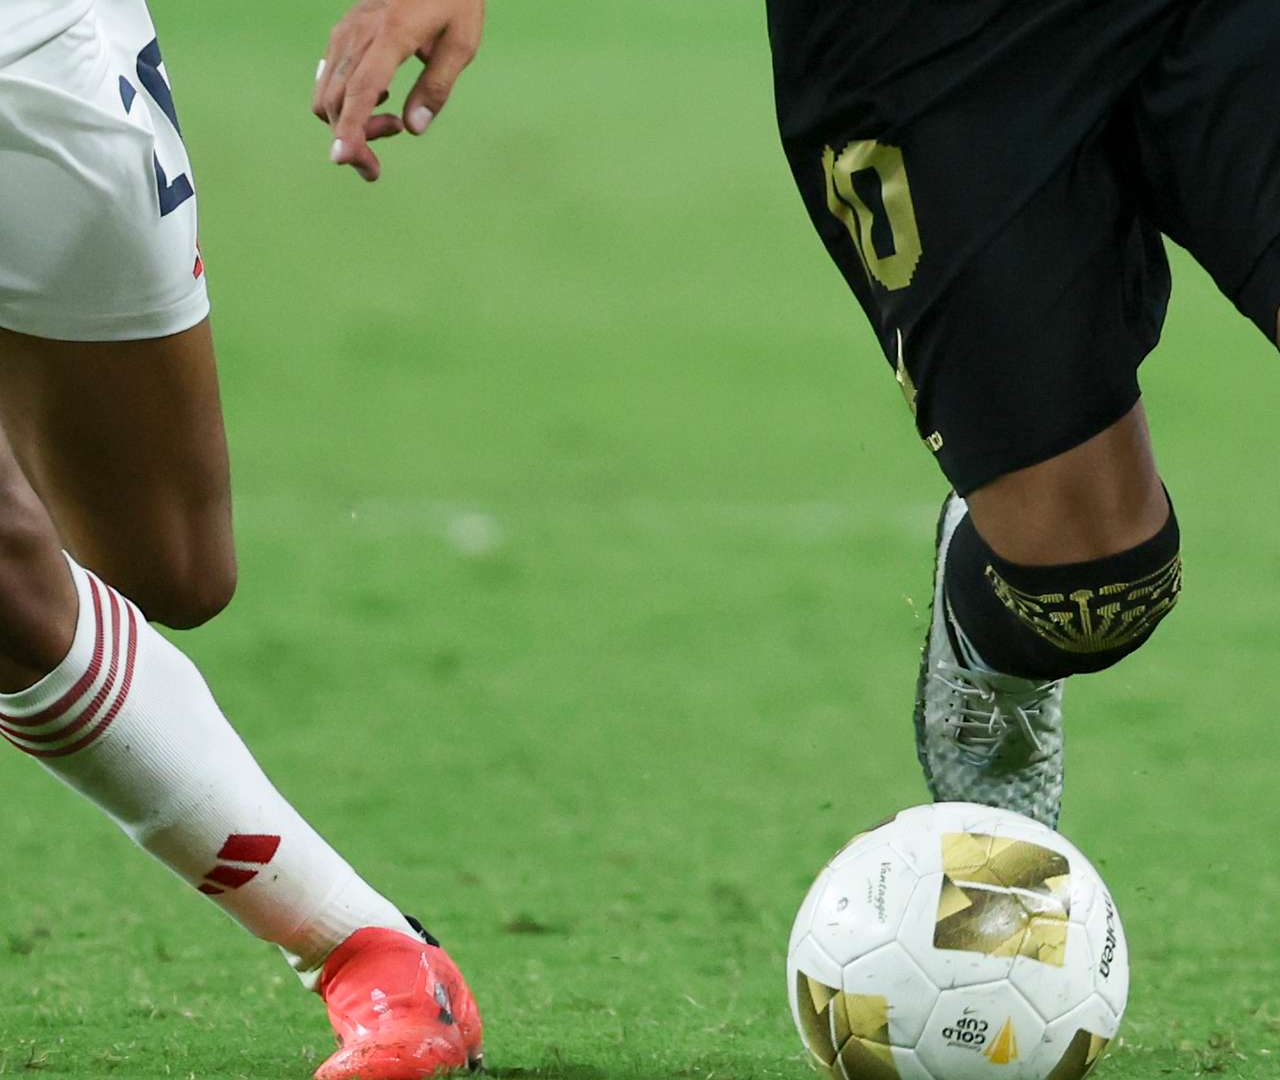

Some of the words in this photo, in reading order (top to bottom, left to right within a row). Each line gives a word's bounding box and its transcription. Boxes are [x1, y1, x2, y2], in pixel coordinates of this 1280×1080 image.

[821, 138, 924, 291] 10
[956, 1018, 989, 1032] CUP
[942, 1027, 986, 1045] GOLD
